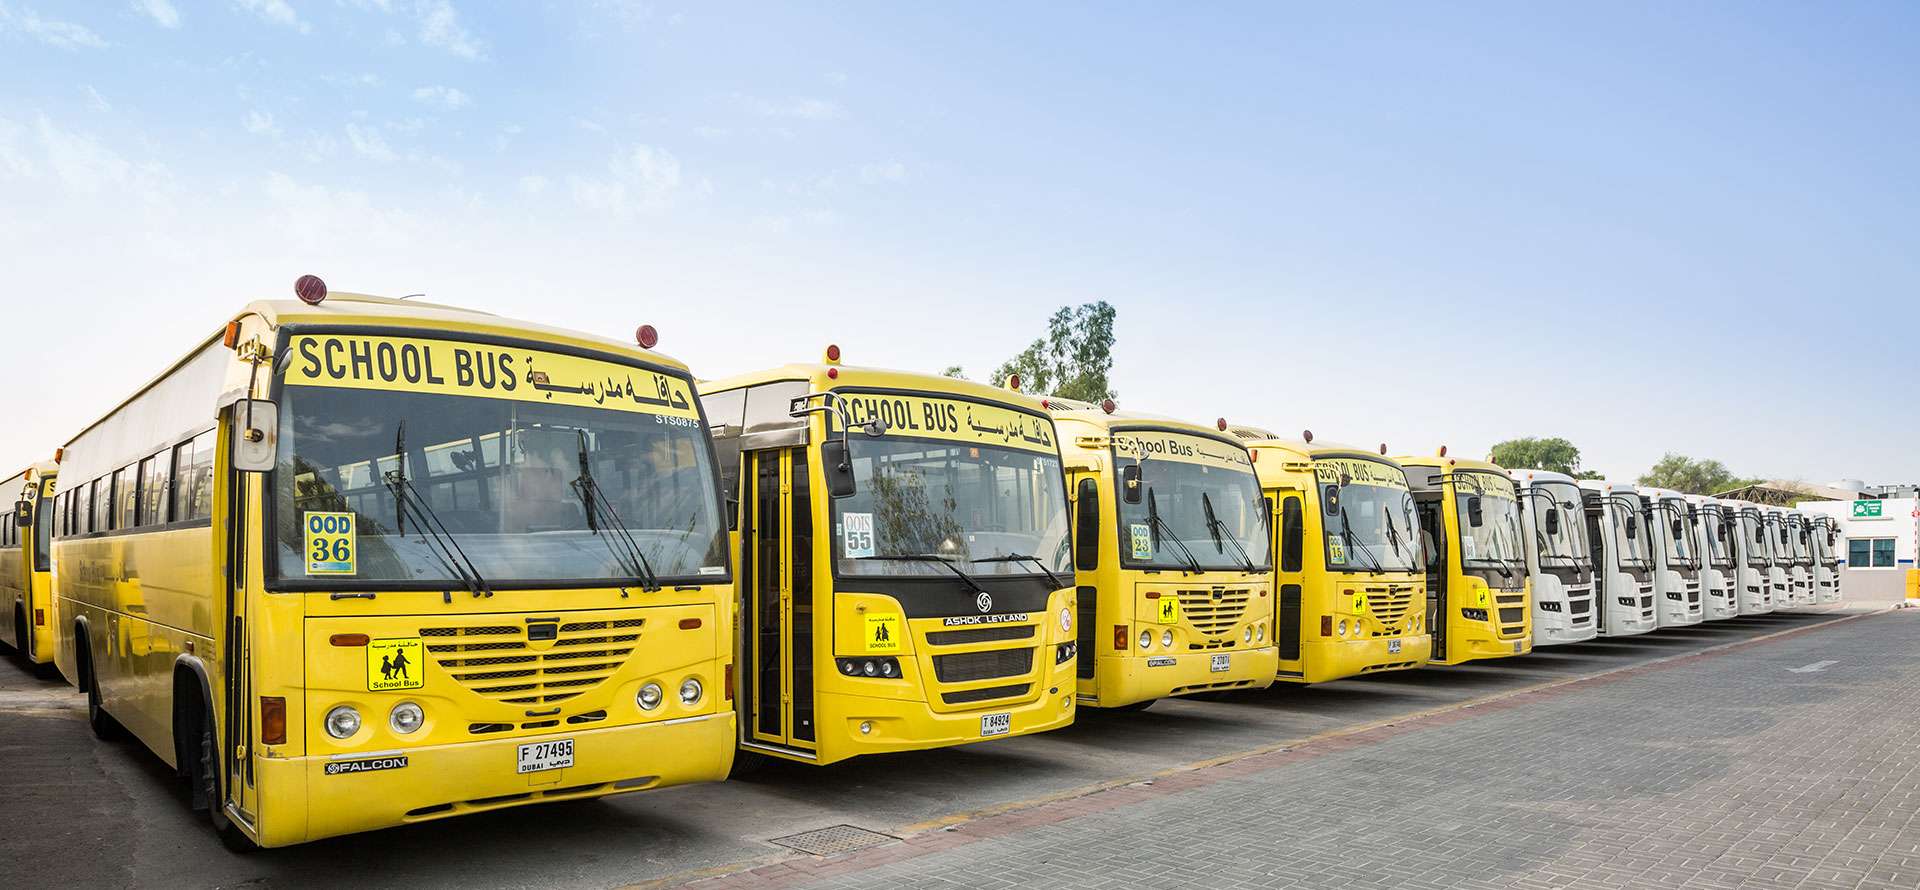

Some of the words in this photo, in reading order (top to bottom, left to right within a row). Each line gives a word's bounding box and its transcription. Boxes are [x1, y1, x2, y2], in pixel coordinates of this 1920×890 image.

[299, 337, 445, 385] SCHOOL
[454, 348, 517, 392] BUS
[655, 414, 699, 429] STS0875
[838, 398, 919, 430] SCHOOL
[923, 402, 959, 433] BUS
[1169, 440, 1193, 457] Bus
[1353, 463, 1370, 482] BUS
[848, 531, 872, 550] 55
[1135, 538, 1149, 552] 23
[312, 538, 351, 562] 36
[1332, 547, 1343, 558] 15
[945, 616, 981, 626] ASHOK
[986, 613, 1028, 623] LEYLAND
[373, 680, 402, 689] School
[403, 679, 420, 687] Bus
[984, 717, 989, 728] T
[990, 714, 1009, 728] 84924
[522, 747, 530, 761] F
[535, 740, 573, 760] 27495
[340, 758, 406, 773] FALCON
[522, 762, 544, 772] DUBAI
